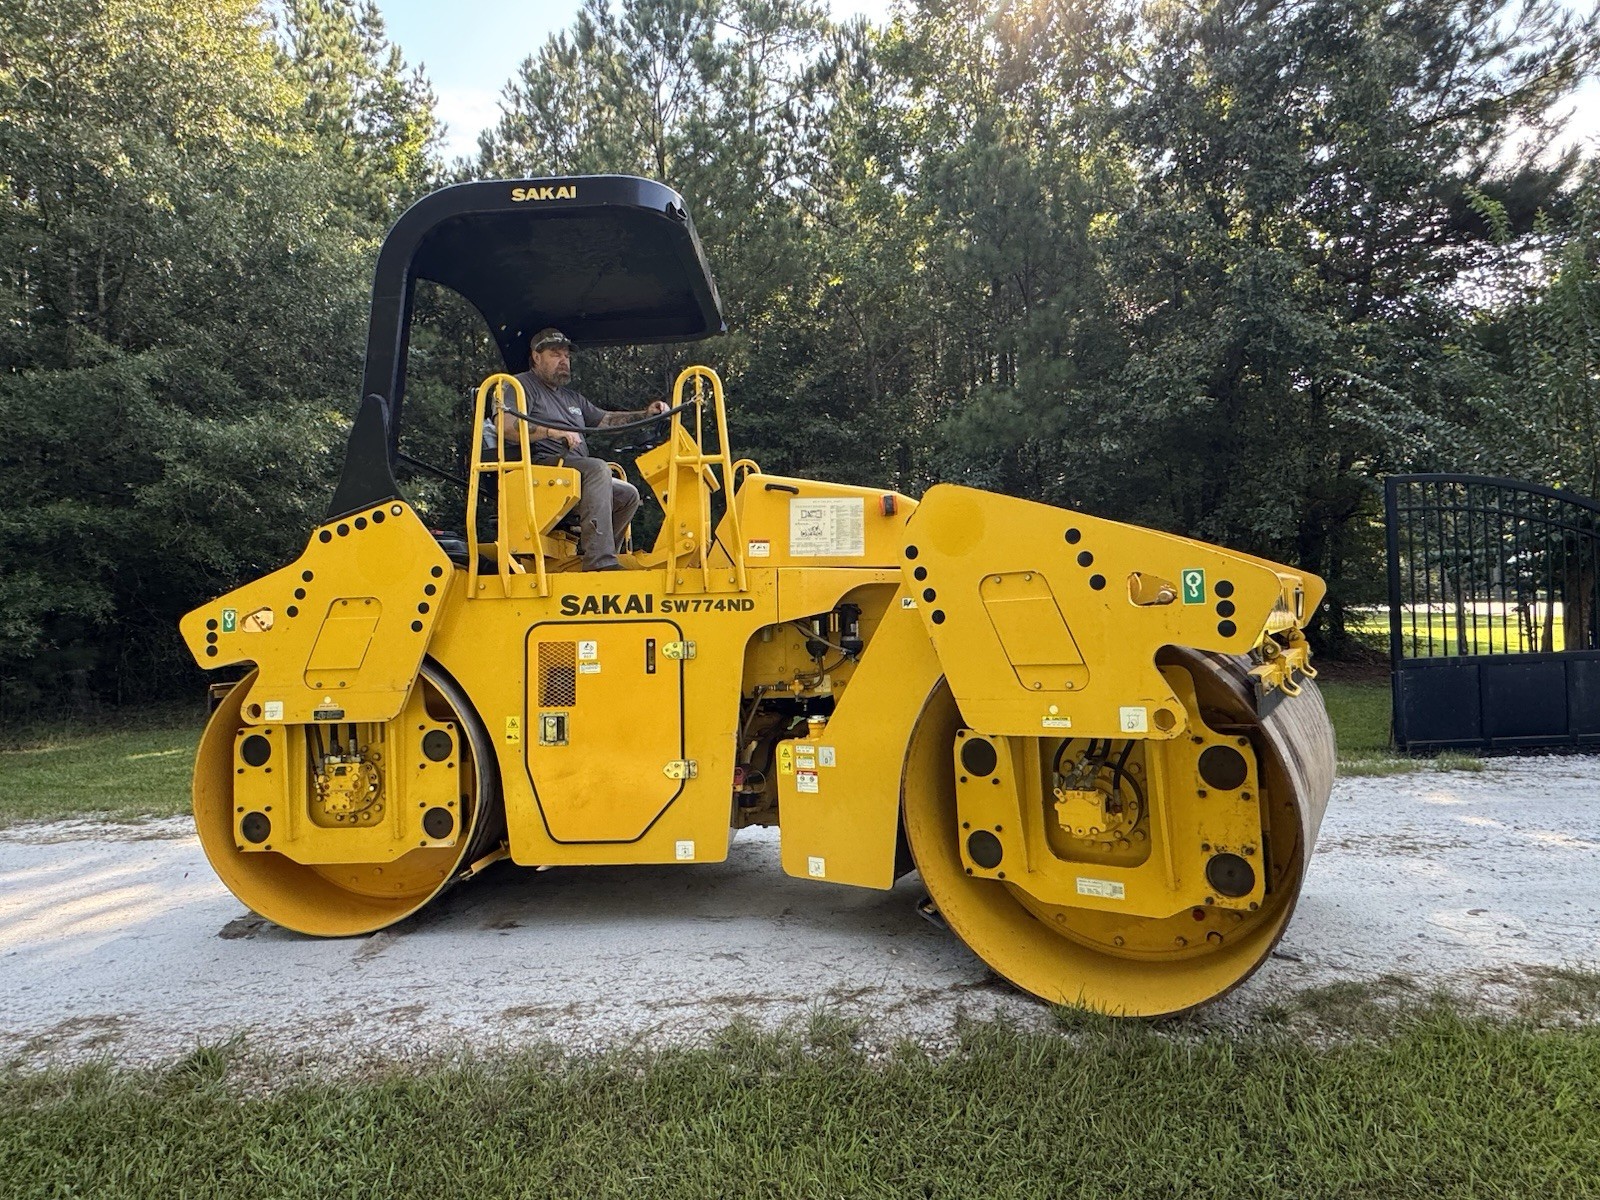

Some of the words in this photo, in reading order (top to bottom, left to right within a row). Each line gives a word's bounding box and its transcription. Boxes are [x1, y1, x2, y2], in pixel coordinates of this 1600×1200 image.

[511, 186, 576, 202] SAKAI
[560, 594, 653, 616] SAKAI
[660, 598, 755, 613] SW774ND
